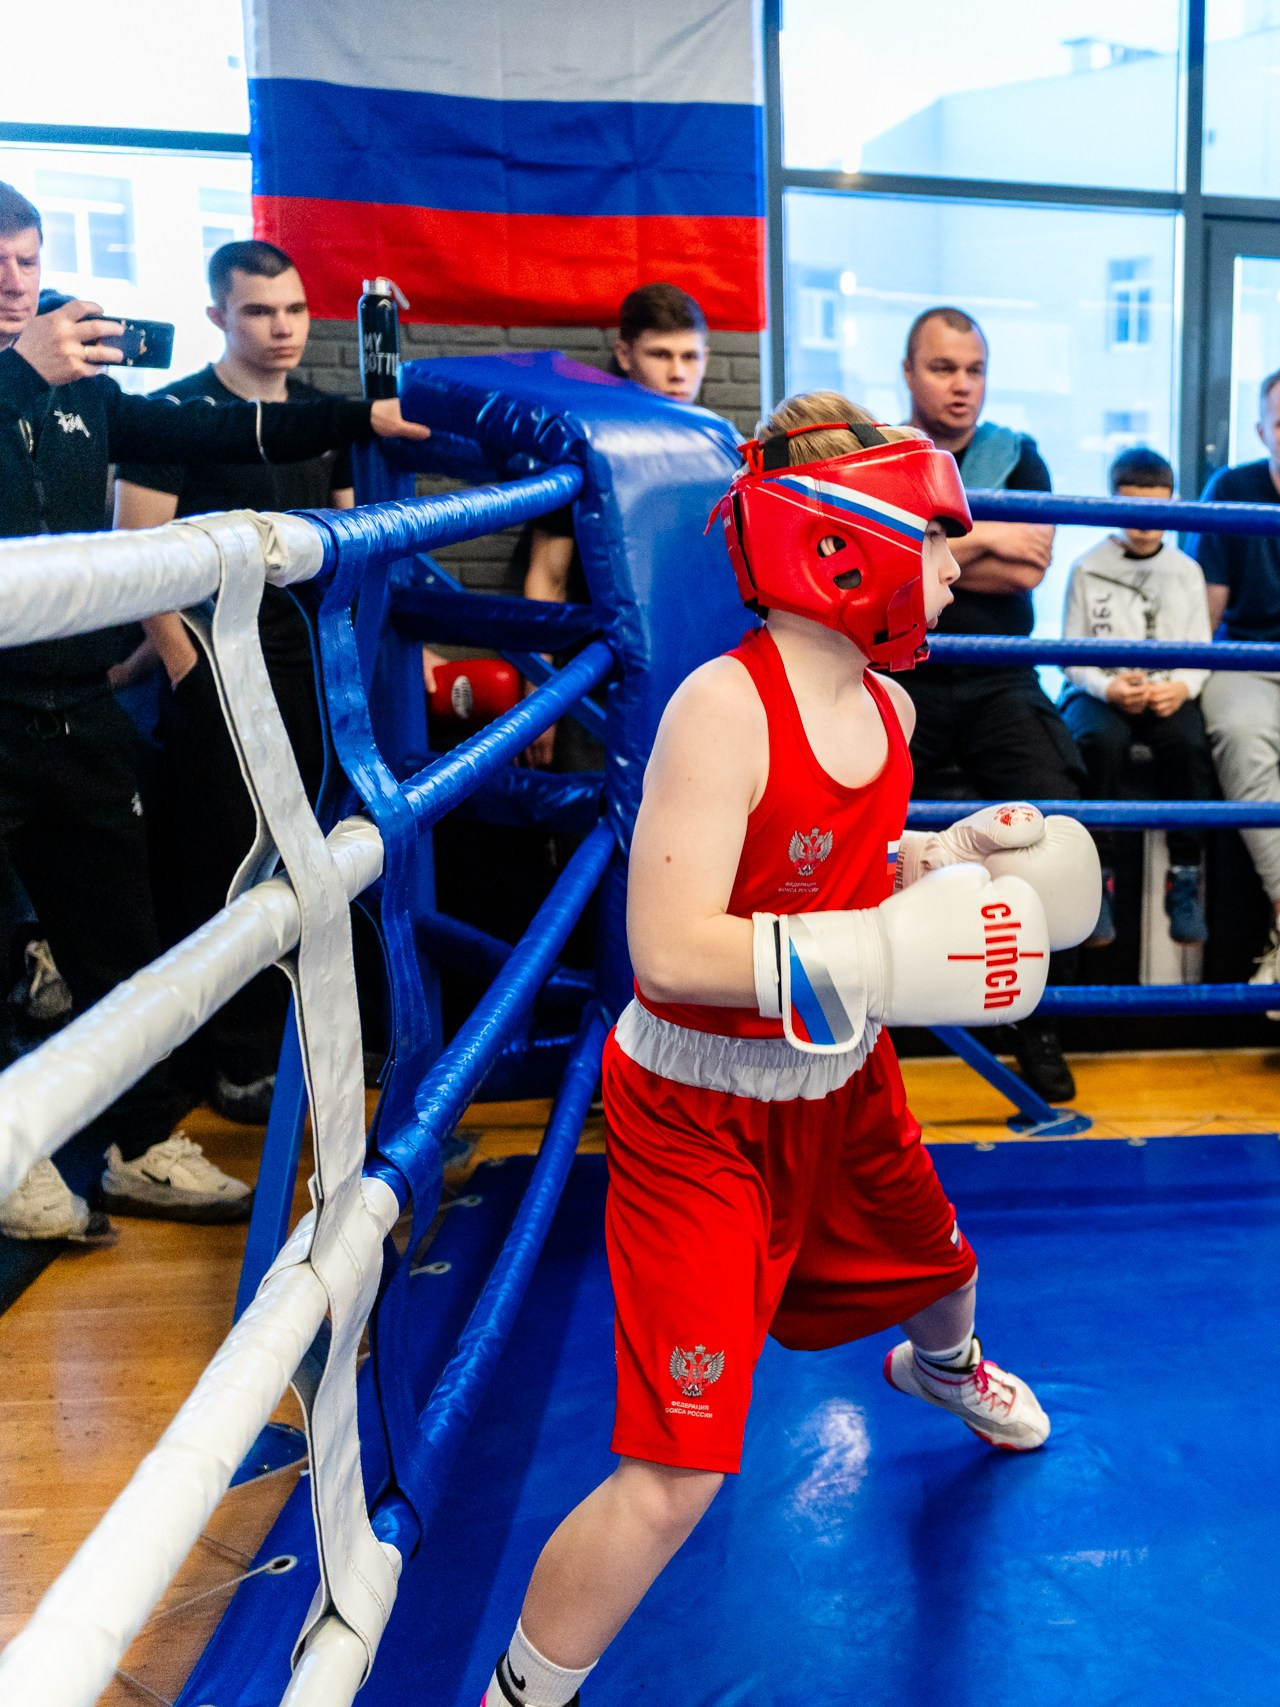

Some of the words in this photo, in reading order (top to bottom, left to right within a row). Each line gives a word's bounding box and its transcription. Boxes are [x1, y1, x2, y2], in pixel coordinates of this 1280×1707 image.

[981, 902, 1022, 1010] clinch
[671, 1400, 710, 1411] ФЕДЕРАЦИЯ
[687, 1410, 713, 1418] РОССИИ
